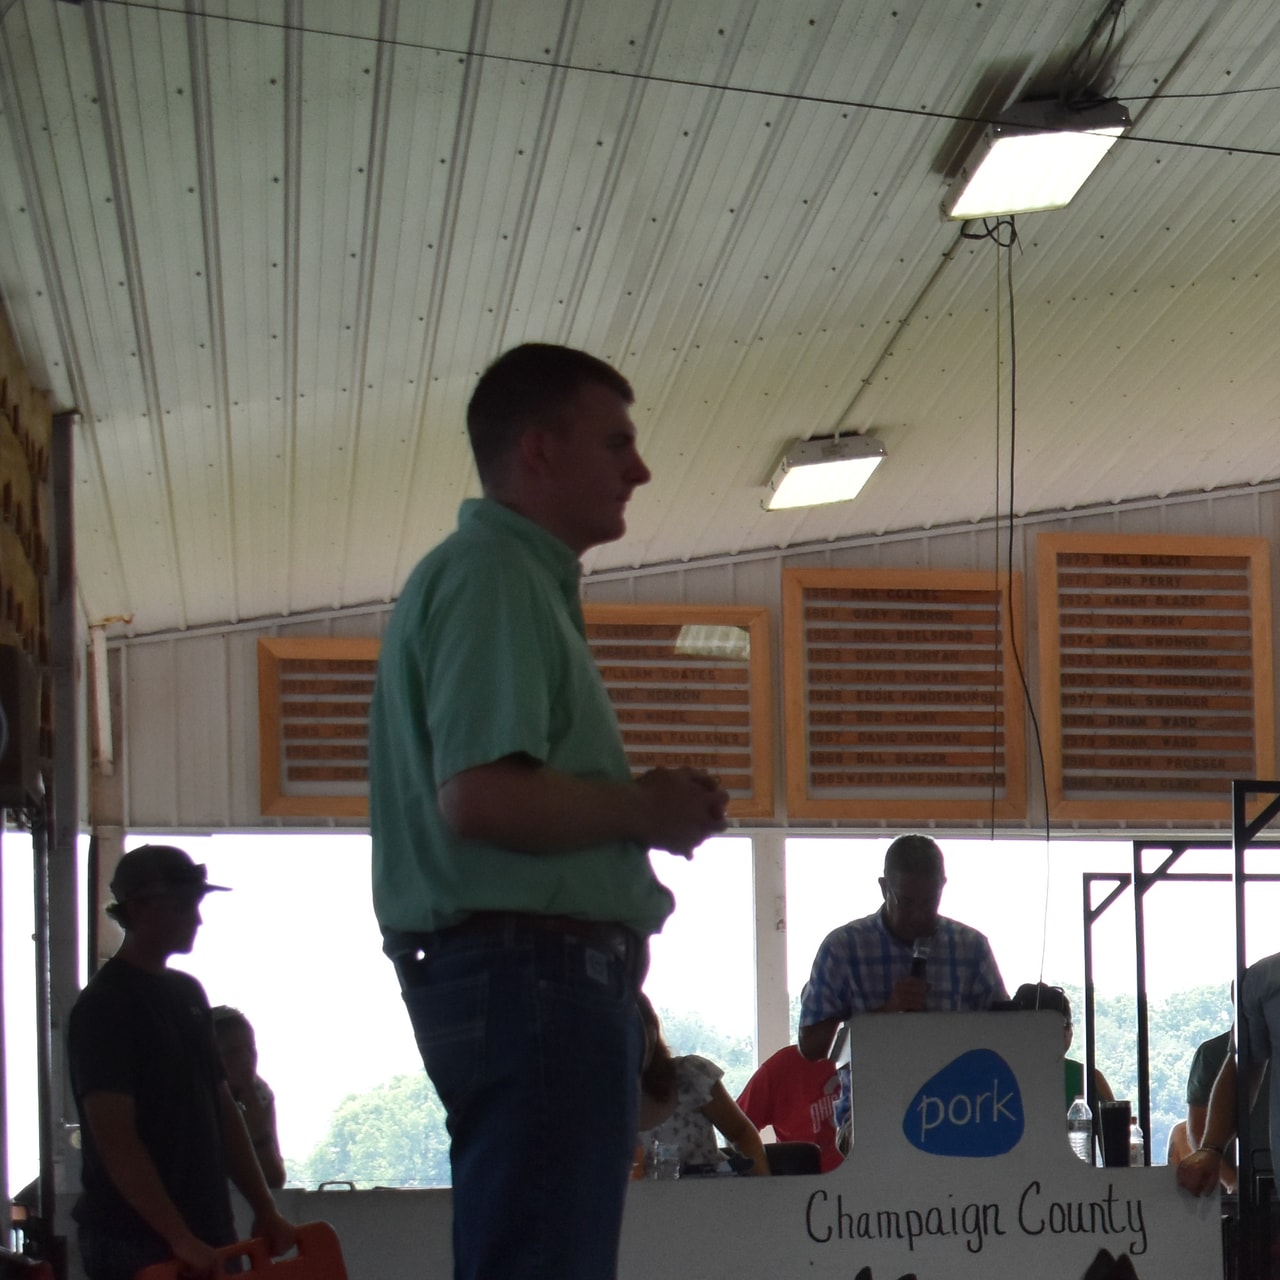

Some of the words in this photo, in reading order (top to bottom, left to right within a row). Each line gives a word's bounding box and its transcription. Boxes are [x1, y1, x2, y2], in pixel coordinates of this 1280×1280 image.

[662, 669, 716, 680] COATES
[917, 1079, 1016, 1142] pork
[806, 1190, 1005, 1253] Champaign
[1019, 1181, 1147, 1254] County
